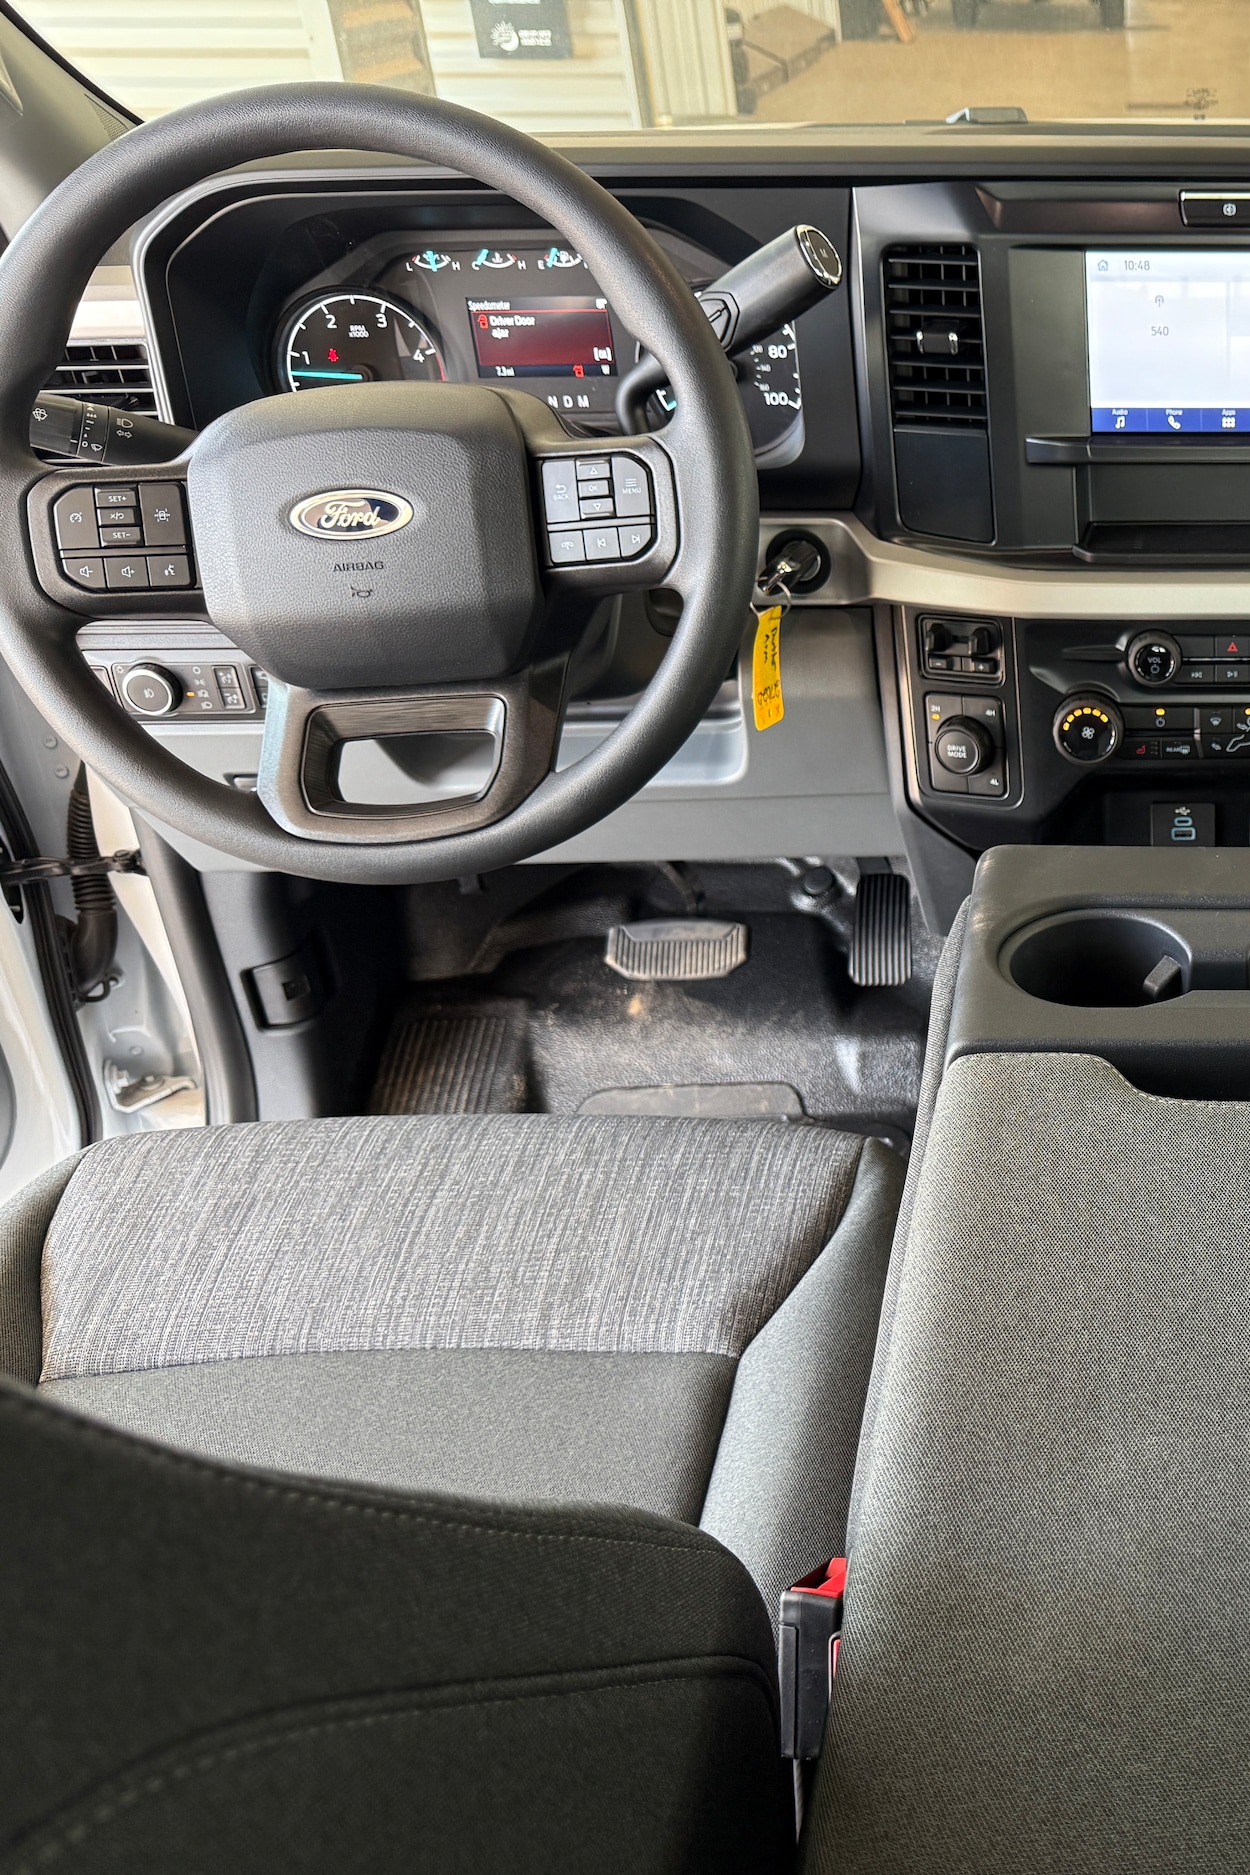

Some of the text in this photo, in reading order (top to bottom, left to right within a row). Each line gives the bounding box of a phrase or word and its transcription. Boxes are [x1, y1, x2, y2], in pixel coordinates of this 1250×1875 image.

[406, 262, 413, 272] L
[452, 261, 460, 271] H
[517, 260, 526, 270] H
[538, 260, 546, 270] E
[1124, 260, 1150, 271] 10:48
[468, 300, 510, 312] Speedometer
[325, 314, 337, 329] 2
[375, 313, 388, 328] 3
[489, 315, 535, 327] Driver Door
[1150, 326, 1169, 337] 540
[413, 349, 425, 363] 4
[768, 344, 788, 359] 80
[302, 351, 310, 365] 1
[547, 395, 590, 408] N D M
[763, 391, 789, 406] 100
[553, 493, 569, 501] BACK
[320, 500, 381, 528] Ford
[333, 561, 384, 572] AIRBAG
[985, 709, 996, 717] 4H
[946, 744, 966, 752] DRIVE
[947, 750, 967, 759] MODE
[990, 778, 999, 786] 4L
